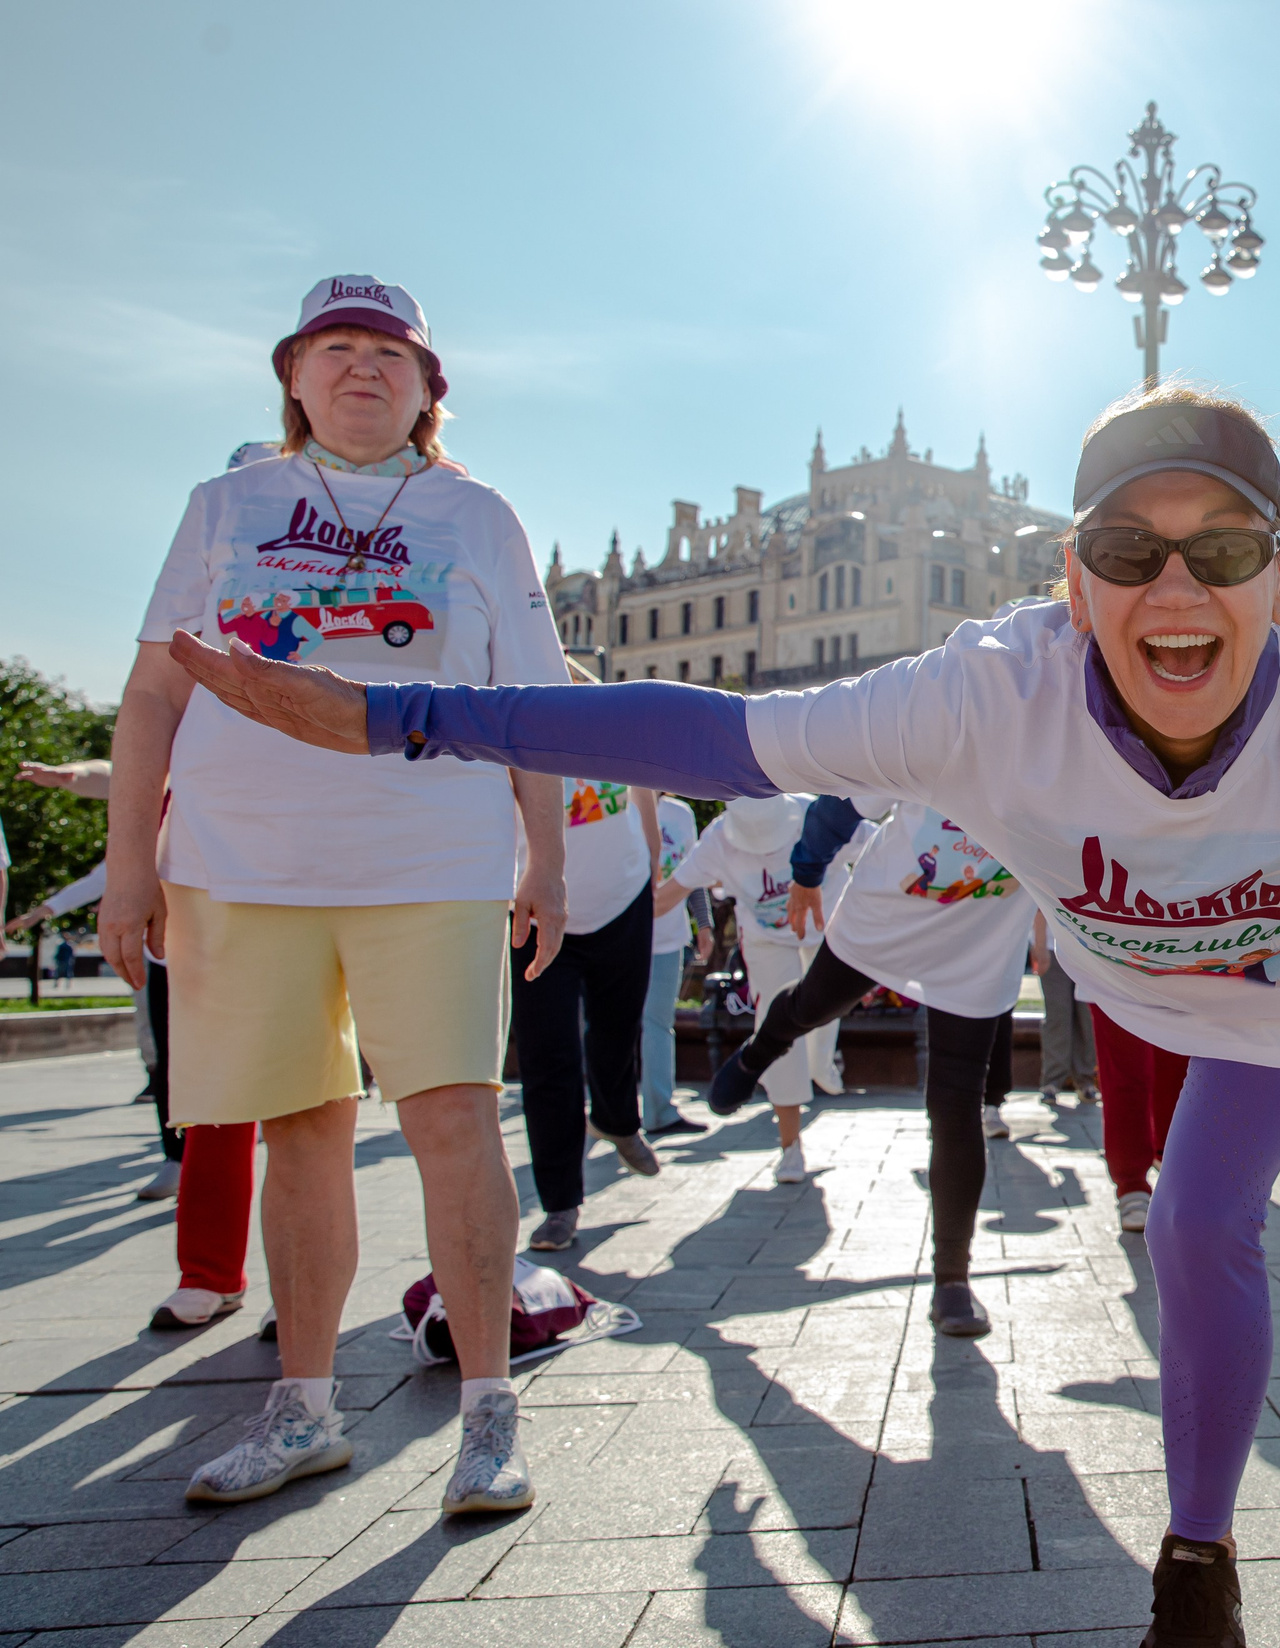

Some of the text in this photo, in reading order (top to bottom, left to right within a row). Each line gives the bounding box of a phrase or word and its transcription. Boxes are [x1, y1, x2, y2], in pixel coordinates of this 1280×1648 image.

[322, 278, 393, 310] Москва
[256, 497, 412, 566] Москва
[317, 608, 374, 634] Москва
